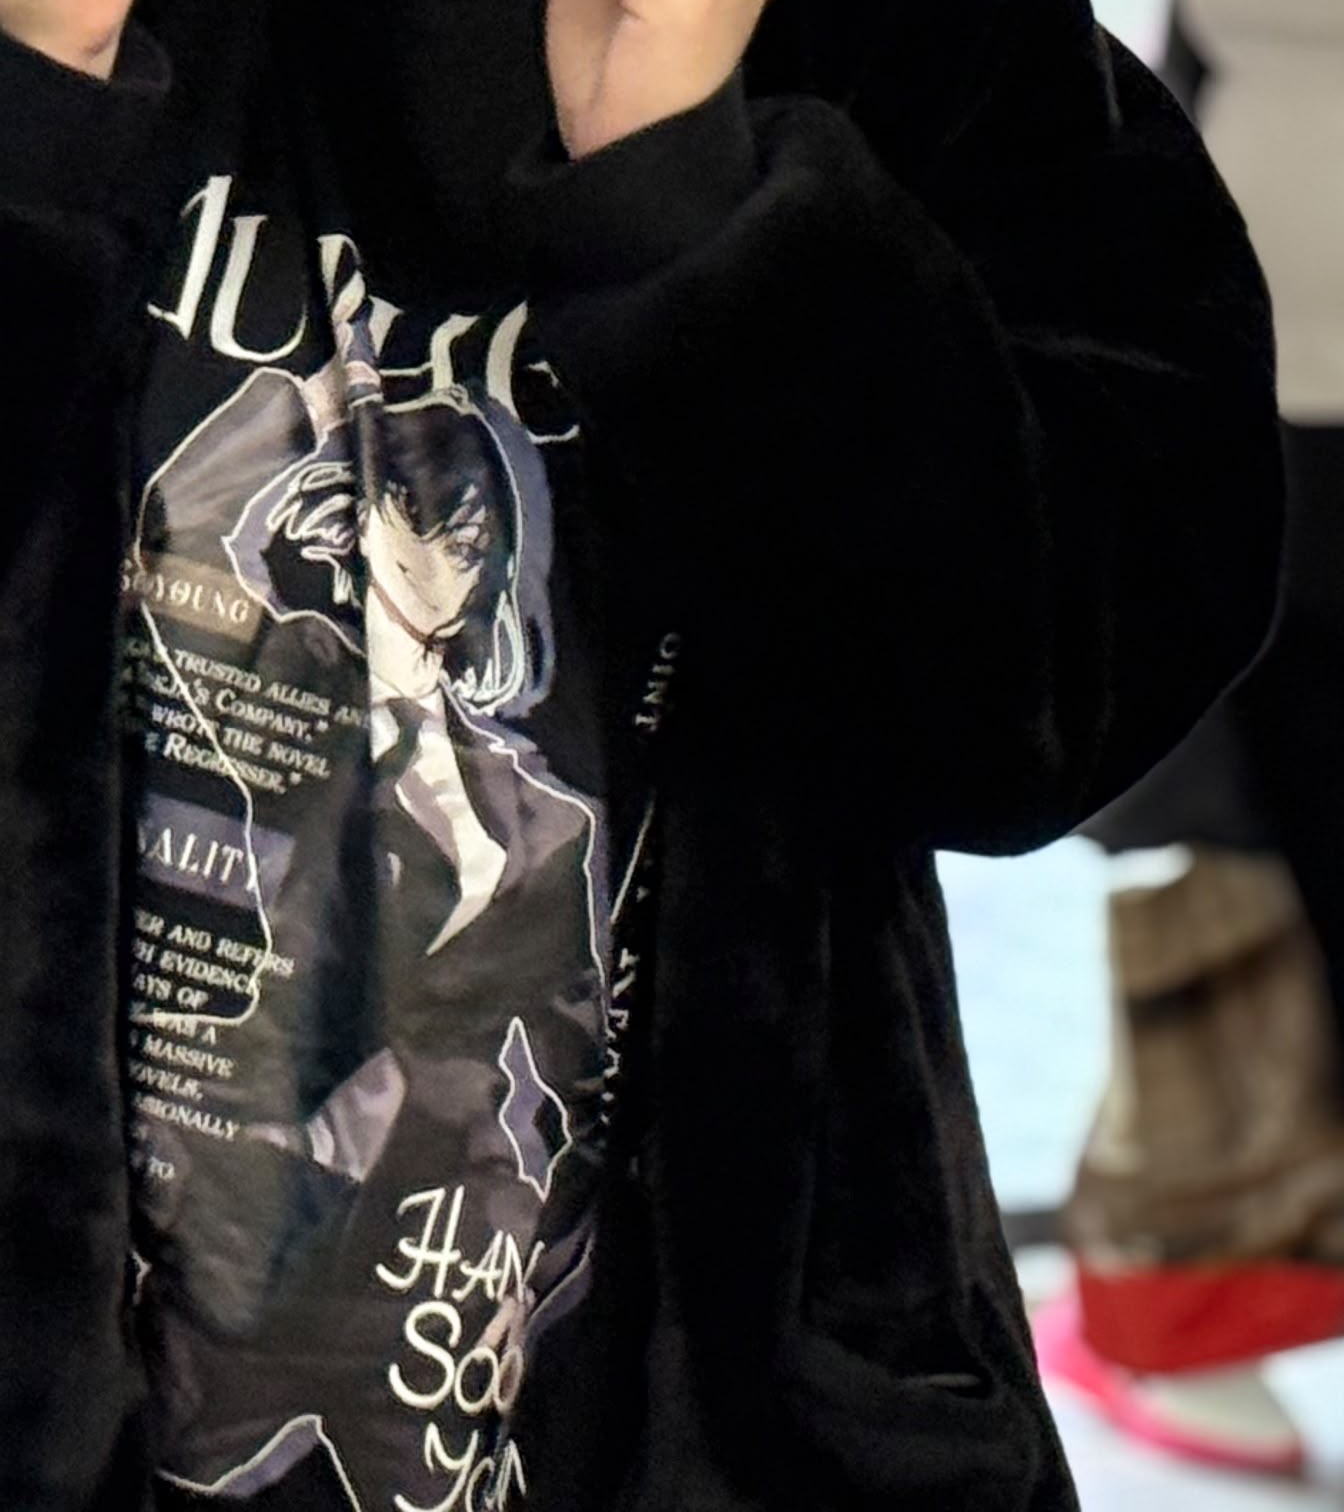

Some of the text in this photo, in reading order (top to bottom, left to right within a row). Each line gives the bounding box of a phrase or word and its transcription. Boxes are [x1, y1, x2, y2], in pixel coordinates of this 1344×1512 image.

[173, 649, 261, 692] TRUSTED
[265, 681, 331, 716] ALLIES
[333, 705, 369, 728] AN
[223, 727, 263, 756] THE
[167, 925, 212, 953] AND
[201, 1024, 218, 1046] A
[375, 1185, 546, 1300] HAN
